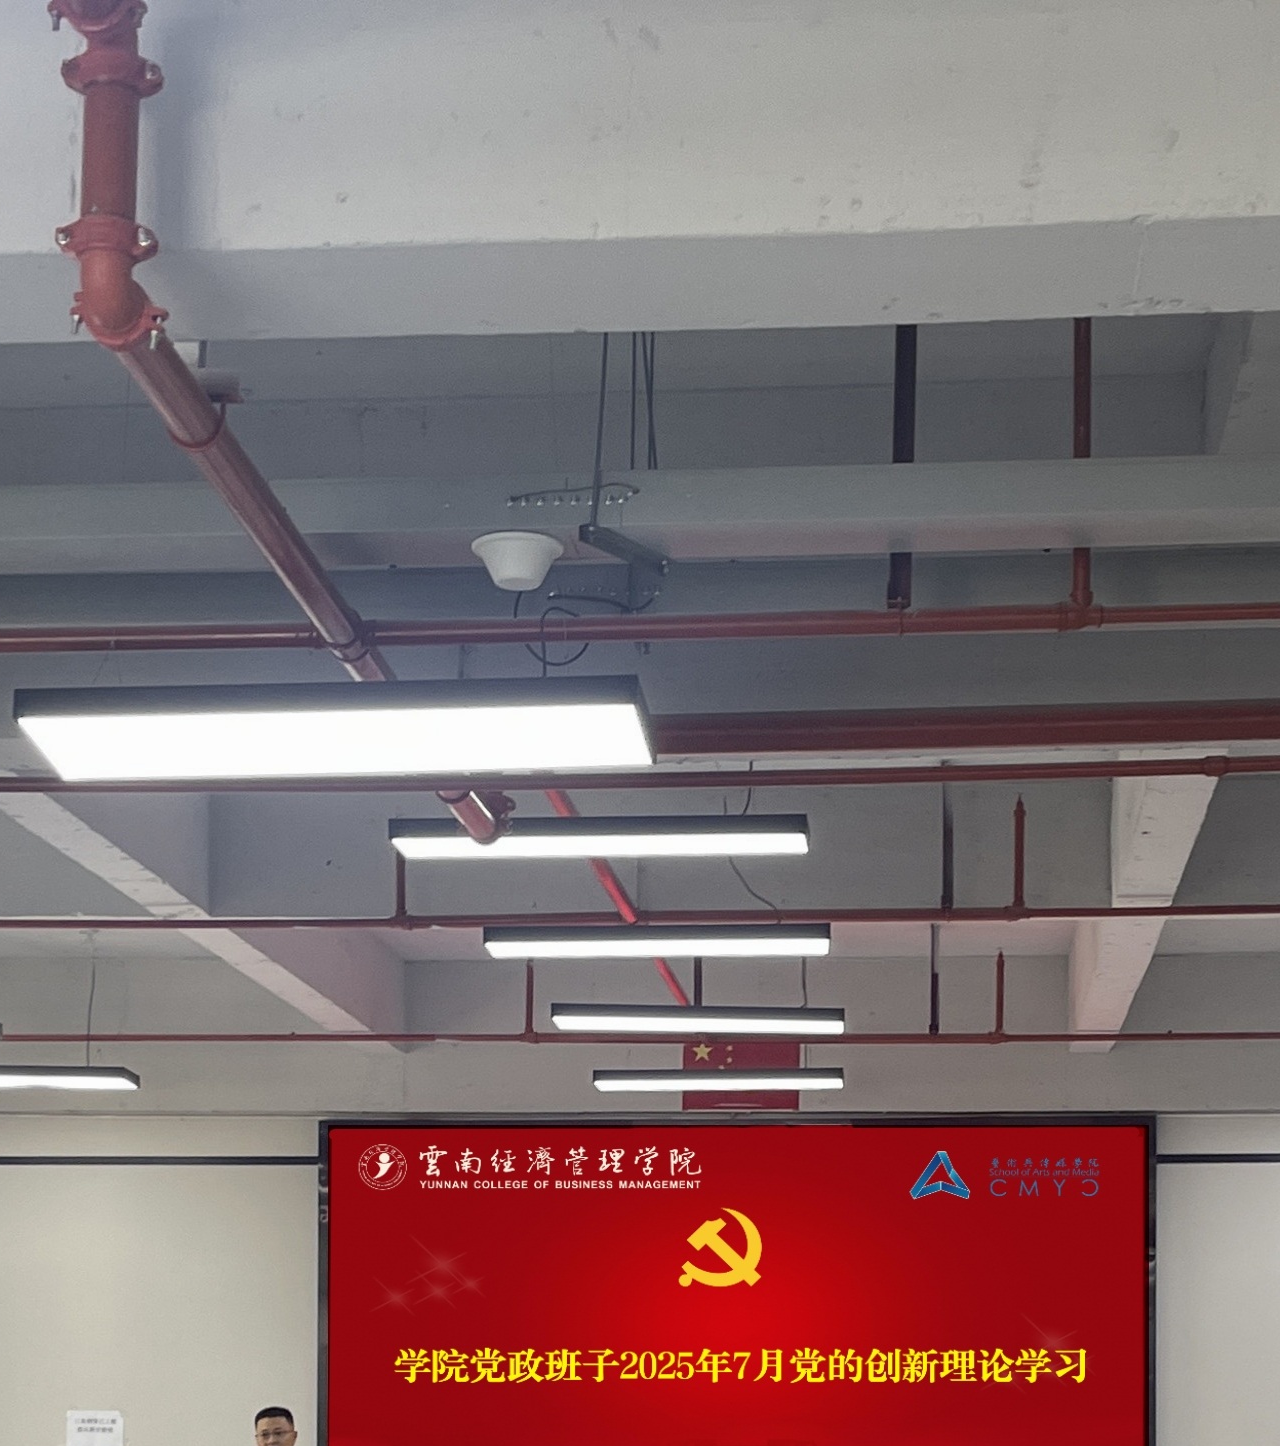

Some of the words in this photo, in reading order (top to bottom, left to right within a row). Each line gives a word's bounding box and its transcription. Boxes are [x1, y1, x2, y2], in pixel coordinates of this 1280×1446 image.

[989, 1168, 1019, 1176] School
[1033, 1168, 1050, 1176] Arts
[1072, 1168, 1100, 1177] Media
[419, 1179, 468, 1189] YUNNAN
[473, 1179, 529, 1189] COLLEGE
[533, 1179, 549, 1189] OF
[554, 1179, 614, 1189] BUSINESS
[618, 1179, 702, 1189] MANAGEMENT
[393, 1347, 1088, 1384] 学院党政班子2025年7月党的创新理论学习
